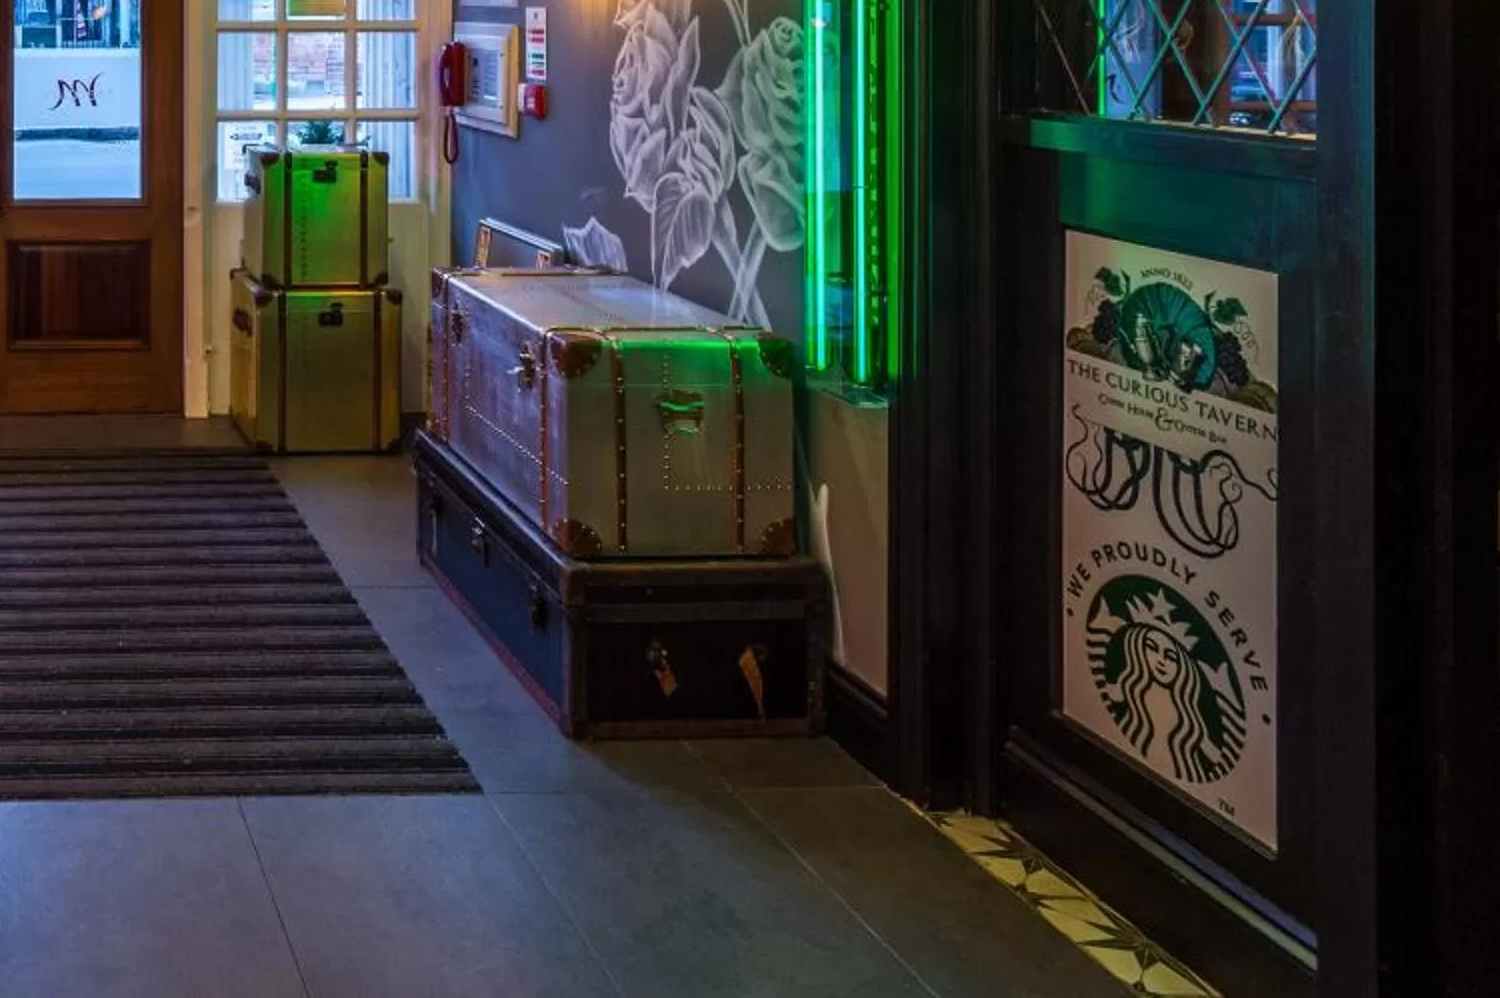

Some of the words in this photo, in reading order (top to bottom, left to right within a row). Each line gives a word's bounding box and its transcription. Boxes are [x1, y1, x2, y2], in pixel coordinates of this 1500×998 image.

[1067, 359, 1100, 383] THE
[1105, 372, 1189, 412] CURIOUS
[1195, 400, 1278, 442] TAVERN
[1067, 564, 1091, 597] WE
[1091, 542, 1197, 585] PROUDLY
[1204, 590, 1269, 691] SERVE
